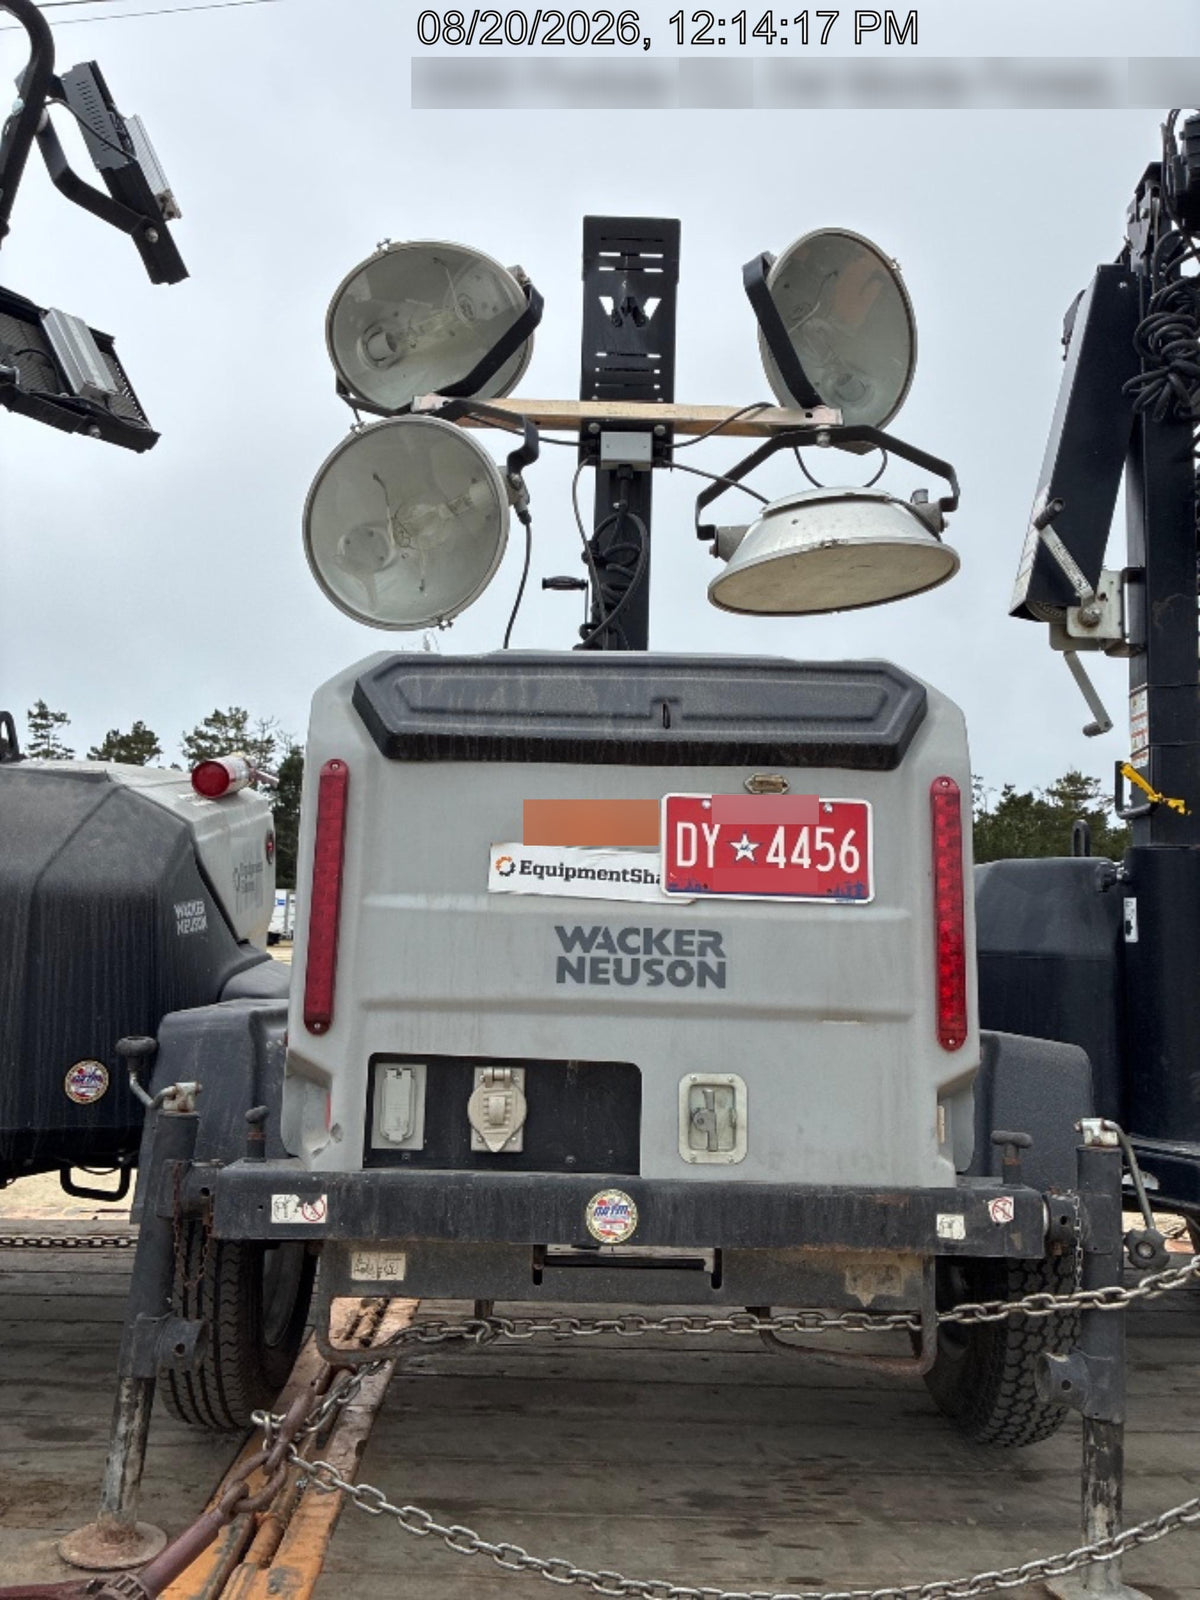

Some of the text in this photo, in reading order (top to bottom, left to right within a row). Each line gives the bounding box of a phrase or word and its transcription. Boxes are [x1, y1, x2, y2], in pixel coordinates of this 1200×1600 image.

[676, 821, 860, 874] DY 4456
[553, 925, 727, 959] WACKER
[556, 956, 727, 989] NEUSON
